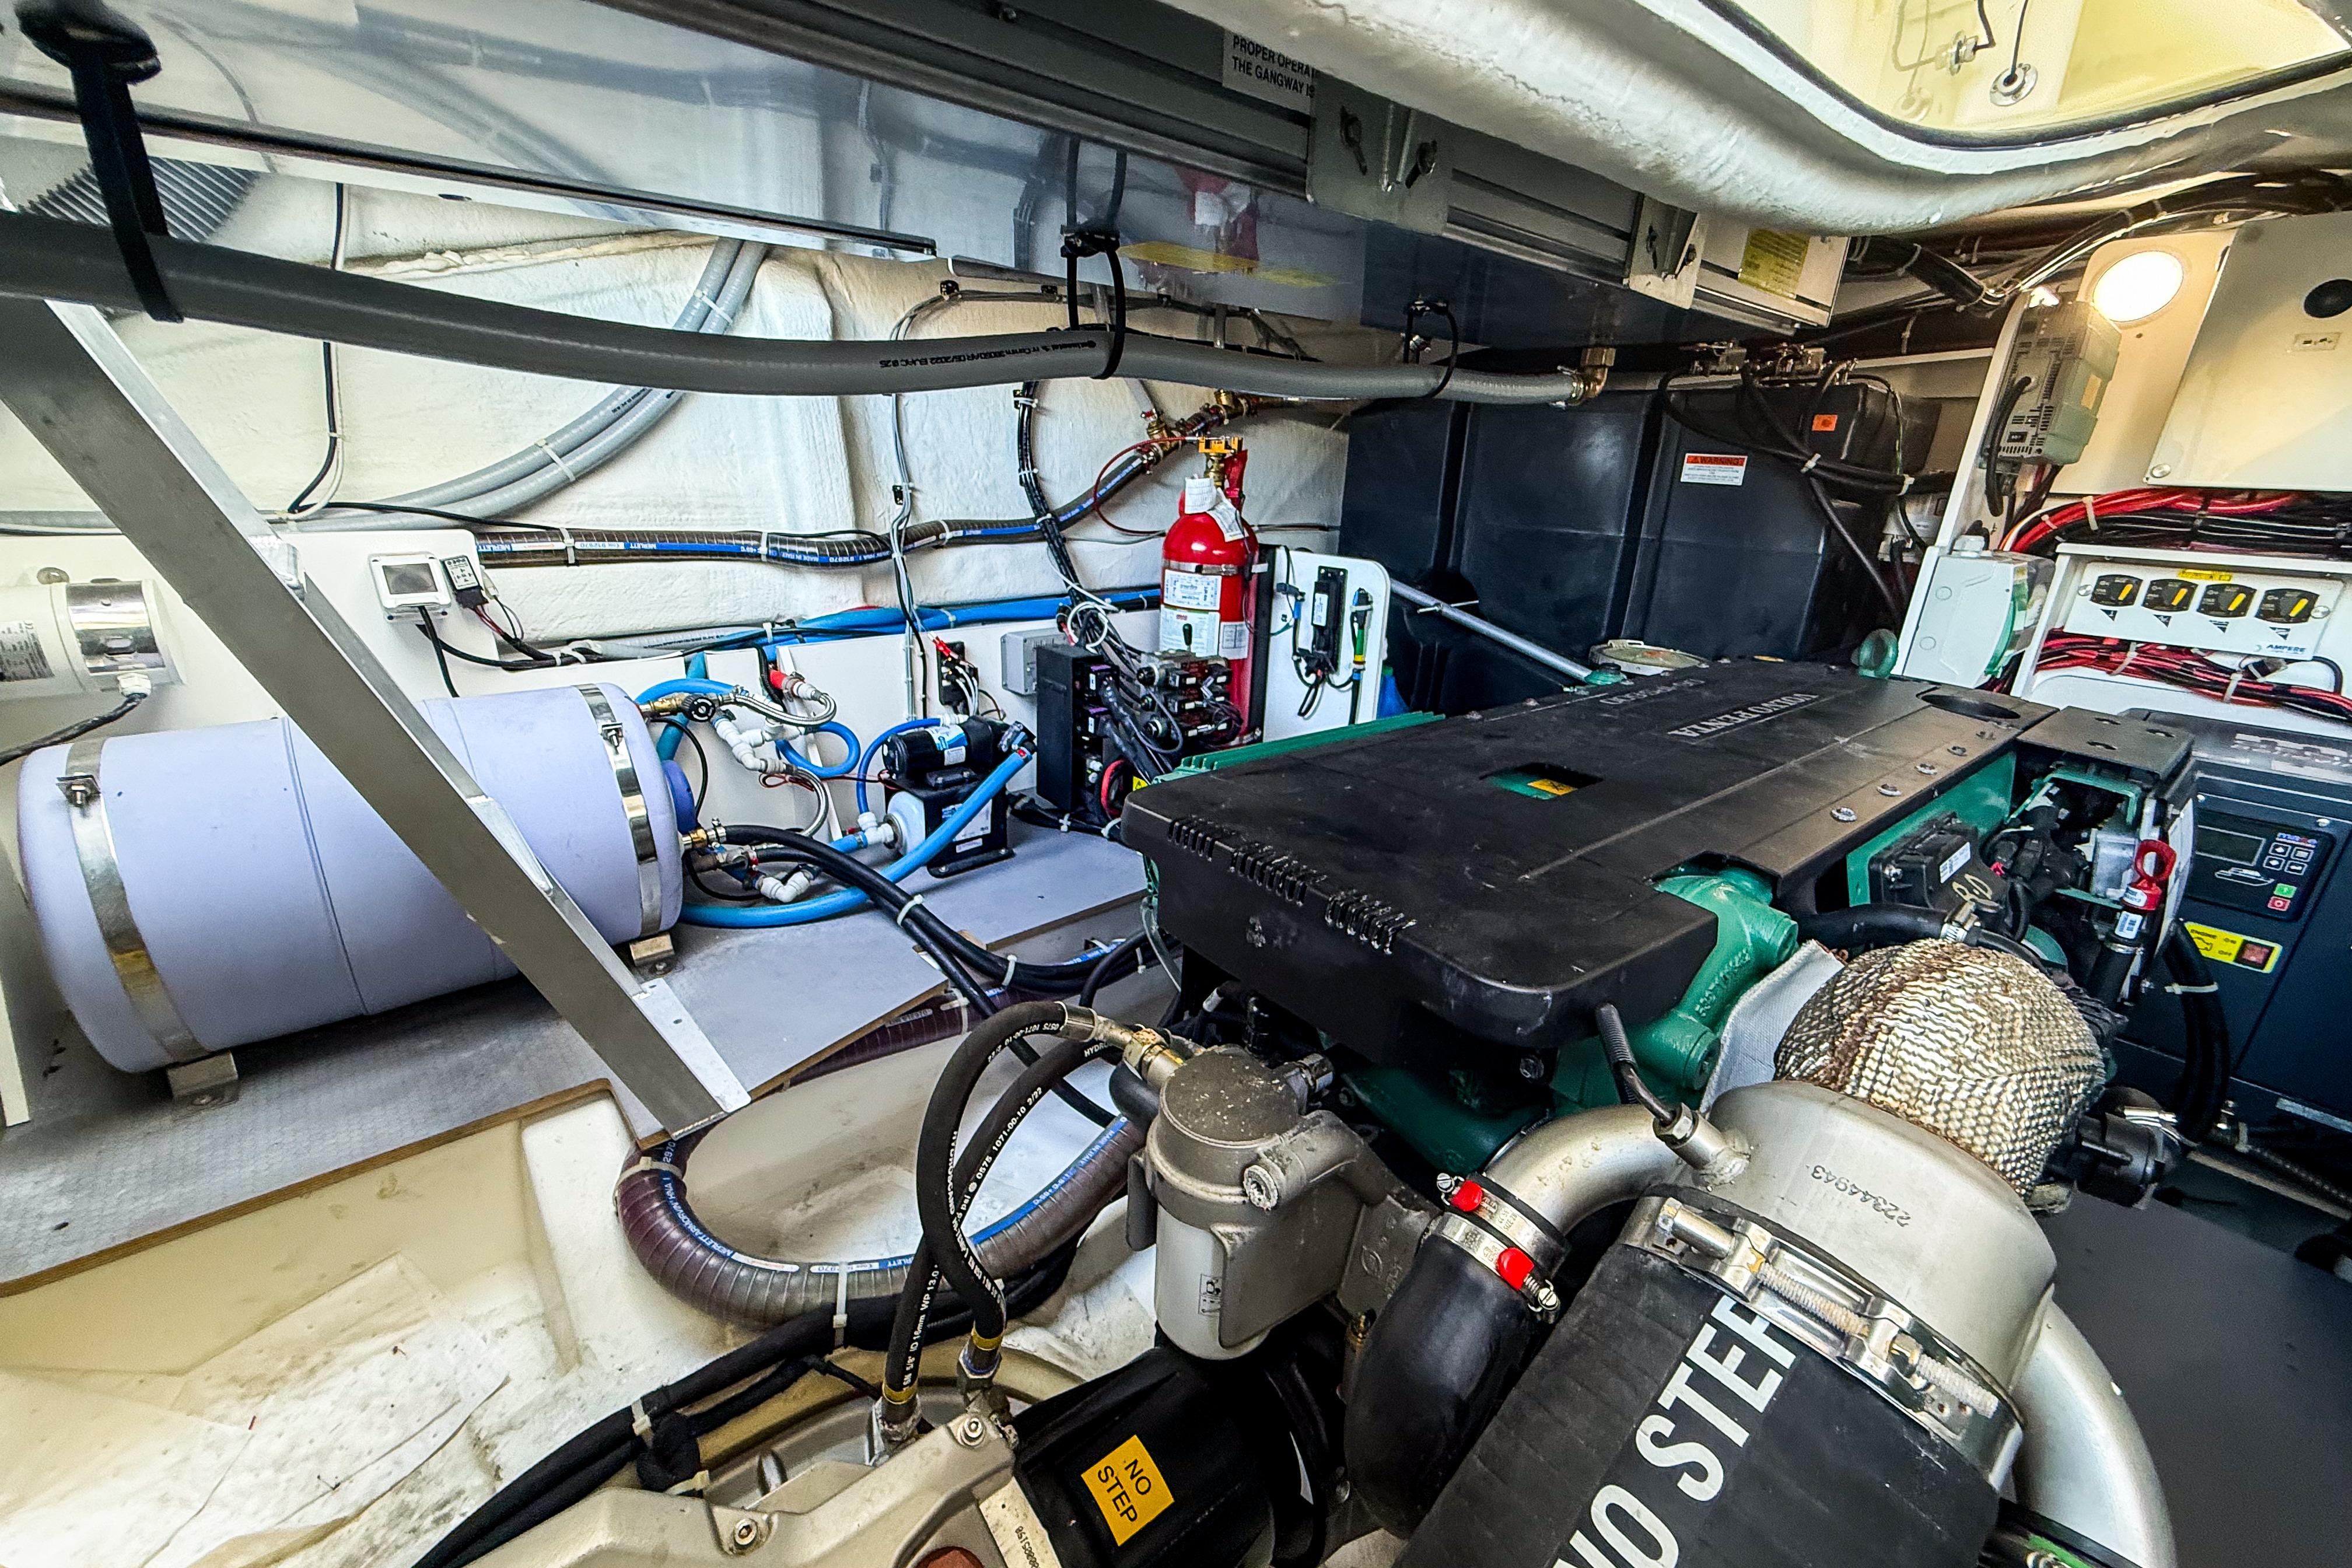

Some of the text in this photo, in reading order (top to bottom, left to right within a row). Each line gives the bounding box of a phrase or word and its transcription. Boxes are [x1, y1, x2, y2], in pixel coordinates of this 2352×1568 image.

[1233, 35, 1275, 64] PROPER
[1232, 56, 1252, 75] THE
[1255, 65, 1304, 93] GANGWAY
[1749, 694, 1818, 709] VOLVO
[976, 1156, 993, 1179] 0575
[991, 1105, 1027, 1153] 1071-00-10
[1811, 1163, 1913, 1228] 22344943
[912, 1314, 926, 1340] 16mm
[920, 1293, 932, 1312] WP
[1096, 1465, 1139, 1522] STEP
[1124, 1458, 1154, 1496] NO
